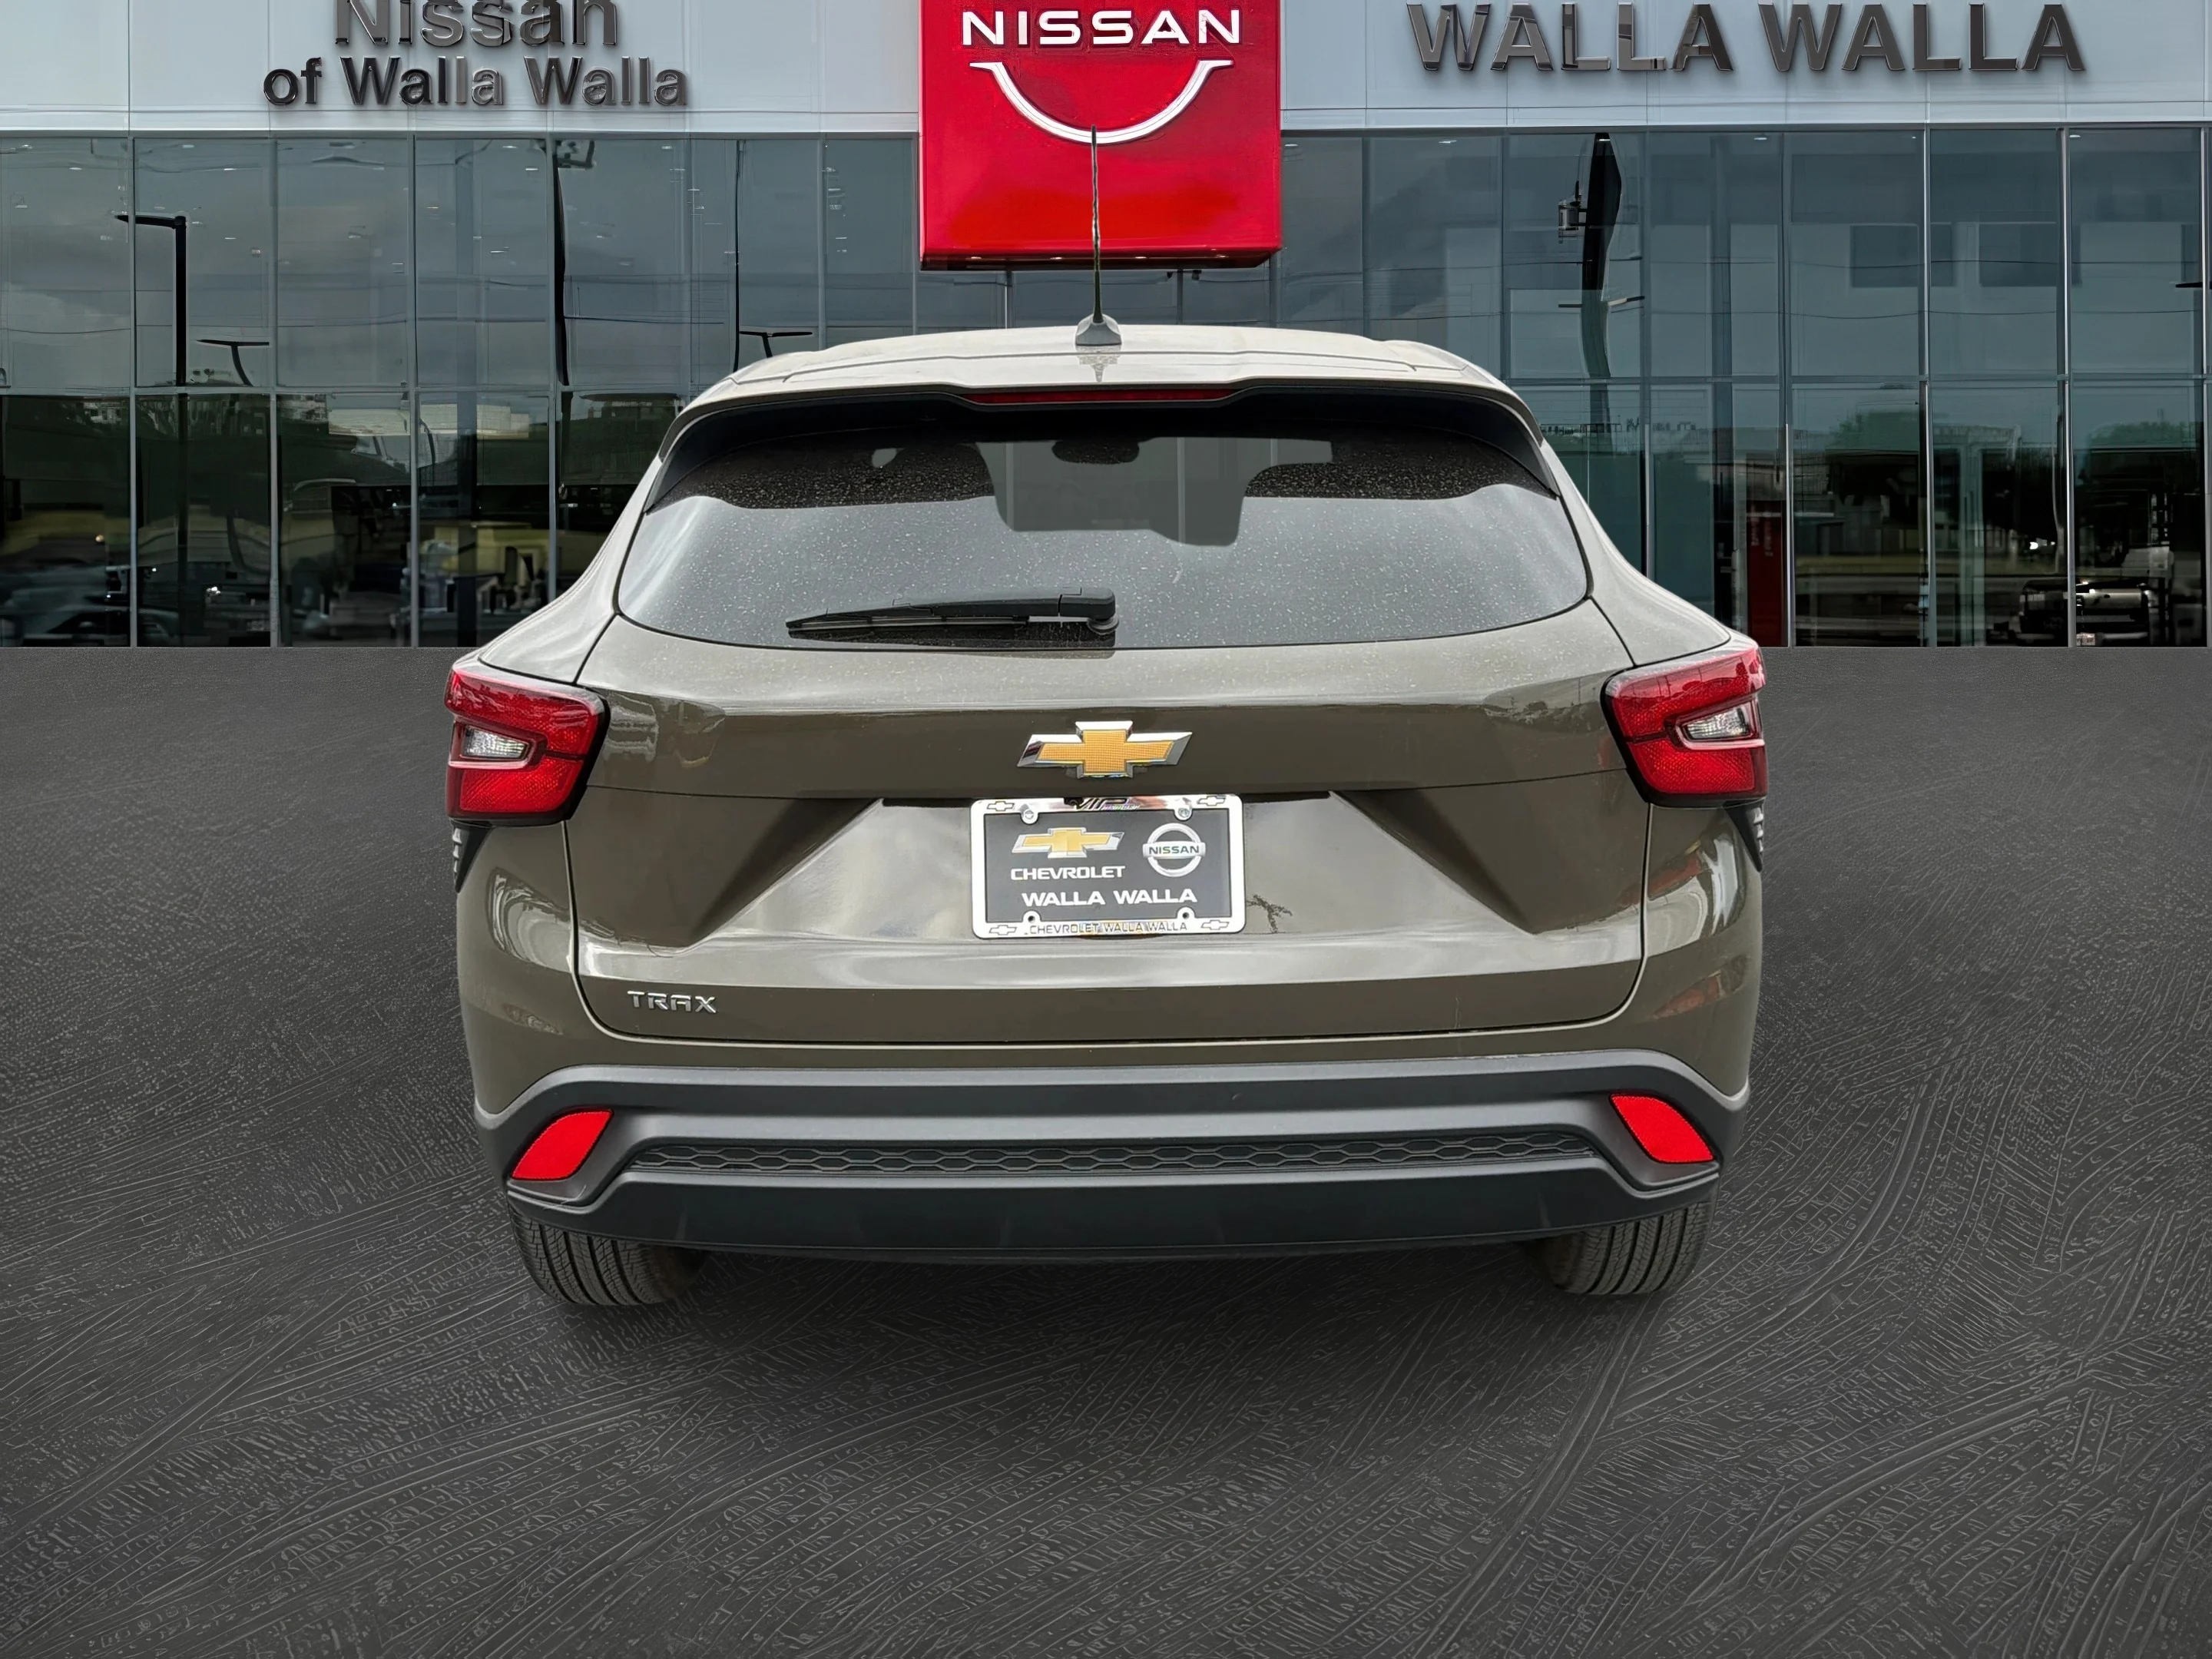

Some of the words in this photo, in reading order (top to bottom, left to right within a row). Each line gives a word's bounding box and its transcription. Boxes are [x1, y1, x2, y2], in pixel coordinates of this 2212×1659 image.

[335, 0, 618, 47] Nissan
[962, 10, 1240, 46] NISSAN
[1407, 3, 1734, 71] WALLA
[1758, 3, 2085, 71] WALLA
[263, 57, 322, 105] of
[339, 55, 505, 105] Walla
[524, 55, 688, 105] Walla
[1148, 845, 1200, 855] NISSAN
[1011, 866, 1126, 881] CHEVROLET
[1022, 891, 1106, 907] WALLA
[1113, 888, 1198, 904] WALLA
[1029, 923, 1098, 935] CHEVROLET
[1103, 922, 1143, 932] WALLA
[1147, 922, 1187, 932] WALLA
[627, 990, 717, 1014] TRAX
